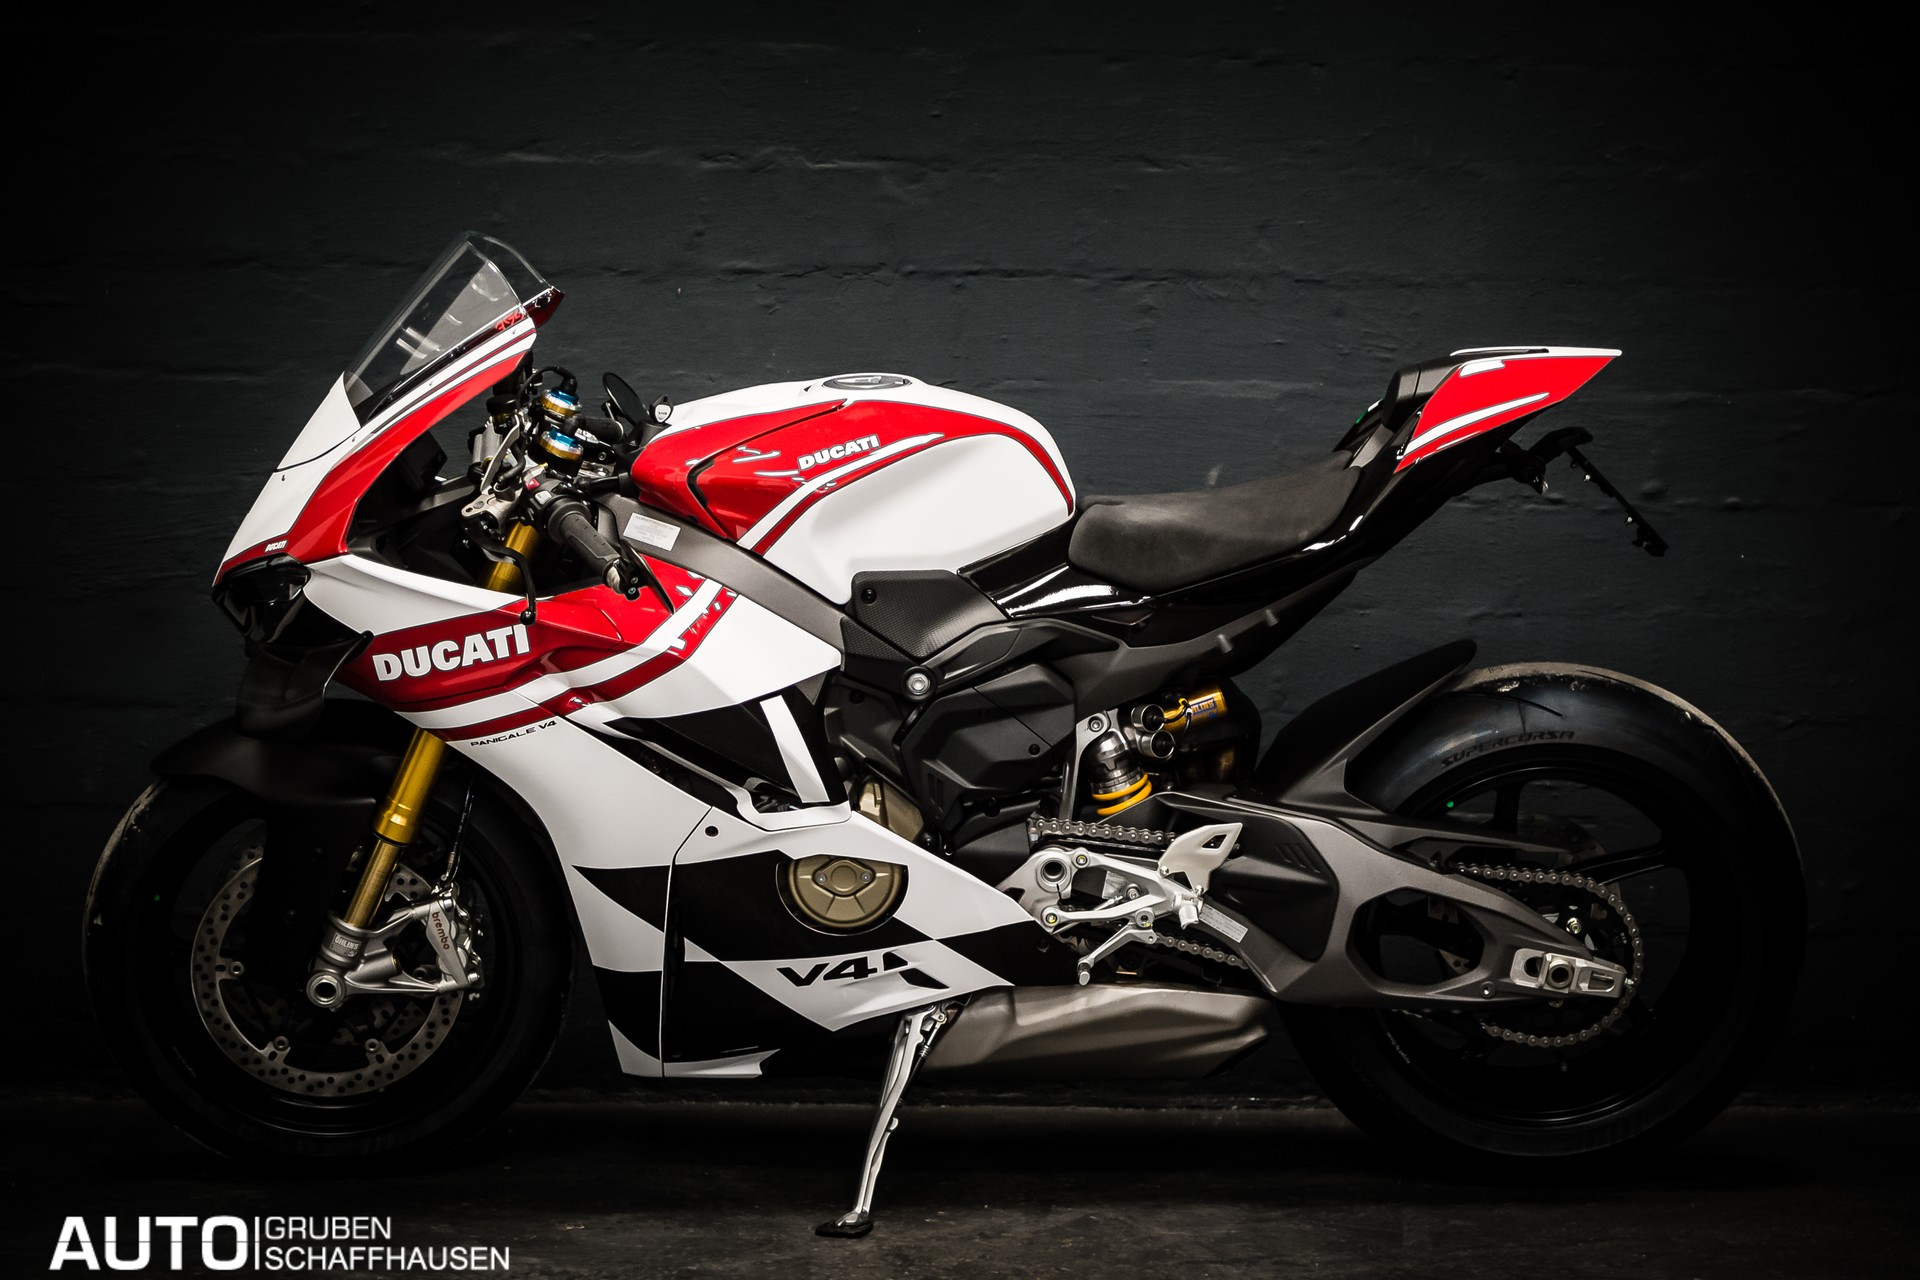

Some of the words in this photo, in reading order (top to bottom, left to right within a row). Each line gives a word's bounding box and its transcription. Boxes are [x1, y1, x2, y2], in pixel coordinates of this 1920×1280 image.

[798, 434, 880, 470] DUCATI
[264, 540, 288, 553] DUCATI
[372, 623, 530, 681] DUCATI
[470, 726, 537, 747] PANIGALE
[538, 720, 558, 730] V4
[1440, 730, 1576, 769] SUPERCORSA
[431, 911, 450, 950] brembo
[775, 955, 878, 988] V4
